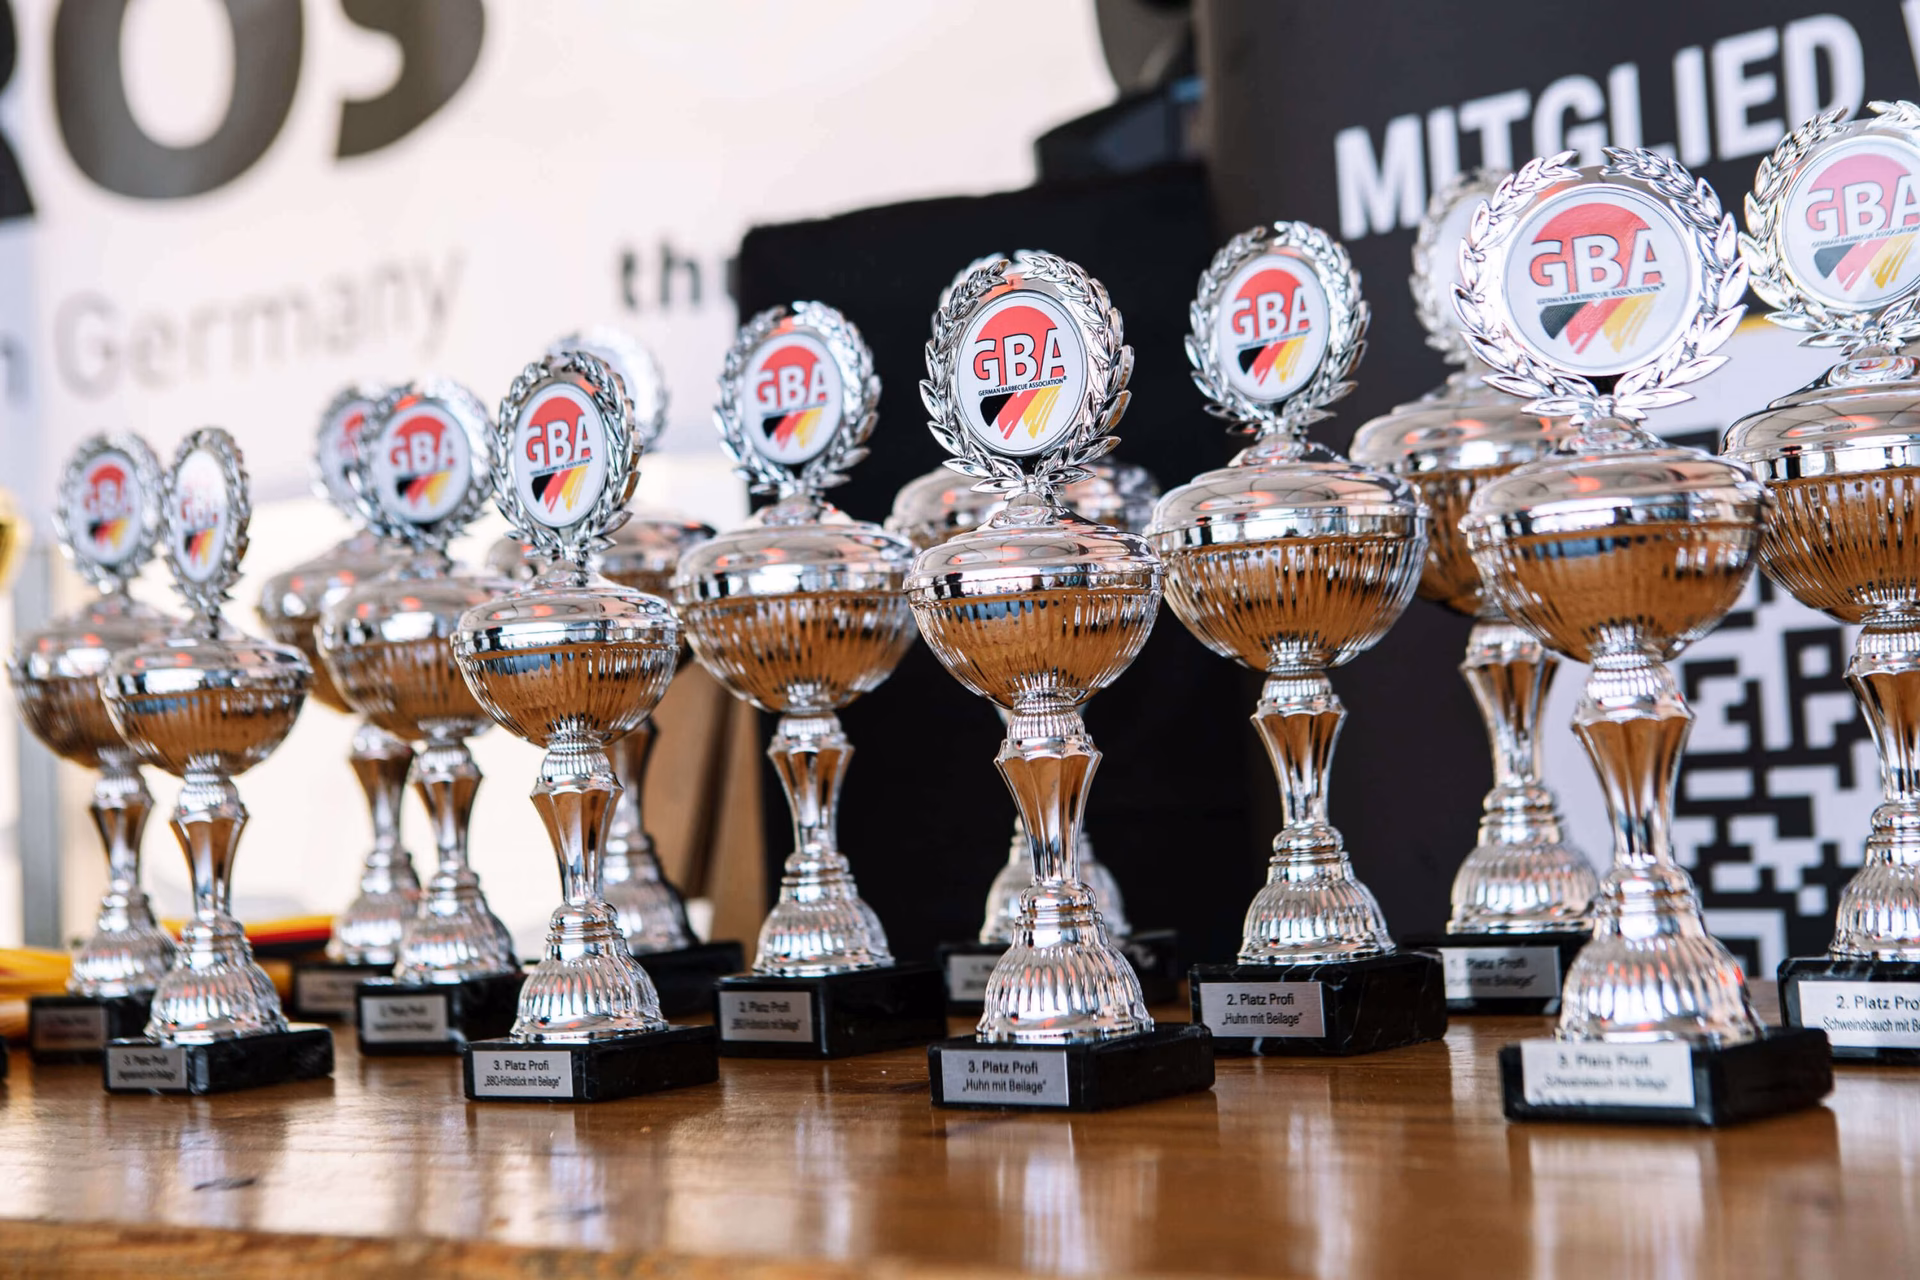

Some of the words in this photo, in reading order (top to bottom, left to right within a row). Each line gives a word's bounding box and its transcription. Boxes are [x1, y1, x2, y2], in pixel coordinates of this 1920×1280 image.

[1334, 12, 1867, 241] MITGLIED
[1805, 173, 1920, 238] GBA
[1529, 227, 1664, 294] GBA
[1231, 285, 1311, 339] GBA
[54, 247, 471, 401] Germany
[972, 327, 1067, 387] GBA
[756, 361, 828, 410] GBA
[978, 386, 1001, 397] GERMAN
[1001, 383, 1028, 394] BARBECUE
[525, 413, 592, 467] GBA
[1226, 993, 1237, 1006] 2.
[1239, 993, 1267, 1006] Platz
[1269, 992, 1295, 1006] Profi
[1836, 994, 1850, 1010] 2.
[1854, 994, 1891, 1010] Platz
[1250, 1012, 1265, 1025] mit
[1895, 1018, 1910, 1033] mit
[493, 1060, 503, 1071] 3.
[505, 1060, 526, 1071] Platz
[528, 1059, 550, 1071] Profi
[968, 1060, 979, 1074] 3.
[982, 1060, 1010, 1074] Platz
[1012, 1060, 1039, 1075] Profi
[528, 1075, 538, 1087] mit
[992, 1080, 1007, 1092] mit
